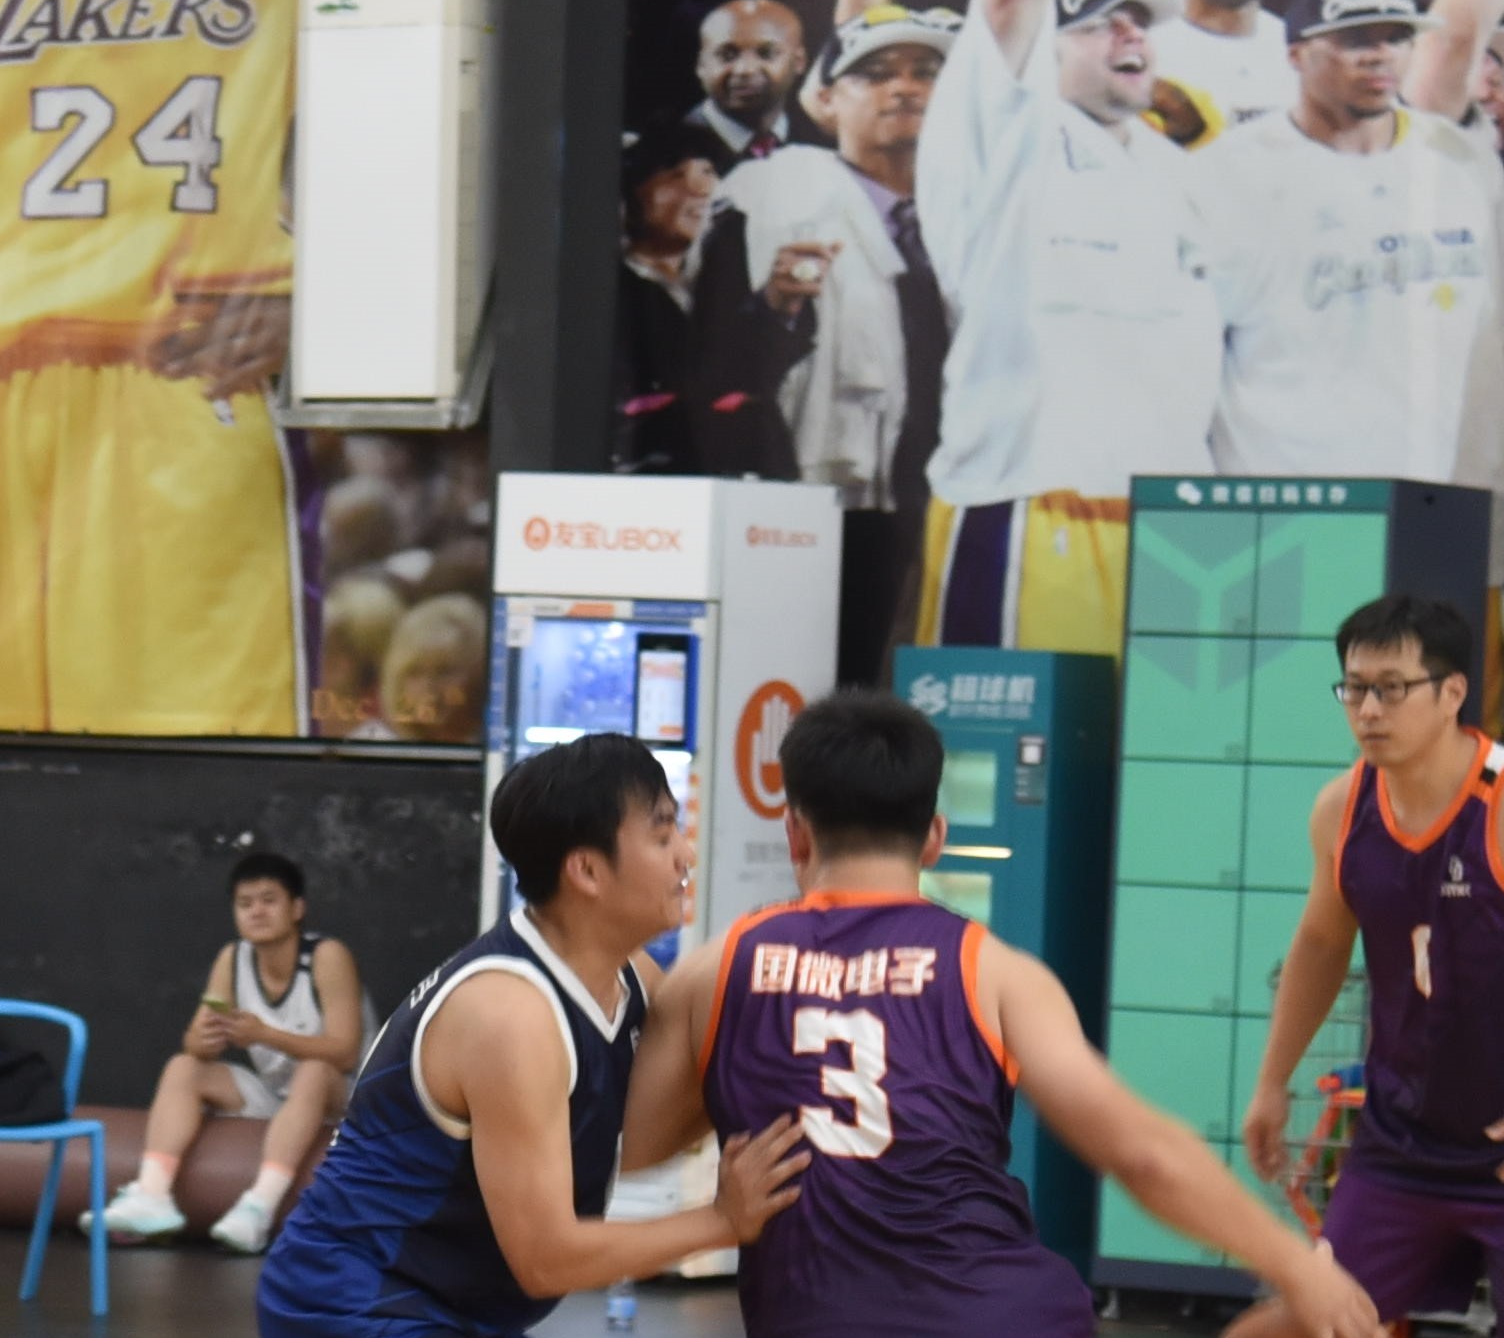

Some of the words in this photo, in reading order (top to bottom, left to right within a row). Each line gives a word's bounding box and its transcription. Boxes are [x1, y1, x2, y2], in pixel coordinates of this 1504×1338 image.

[21, 76, 223, 220] 24
[751, 943, 937, 1002] 国微电子
[793, 1006, 894, 1159] 3
